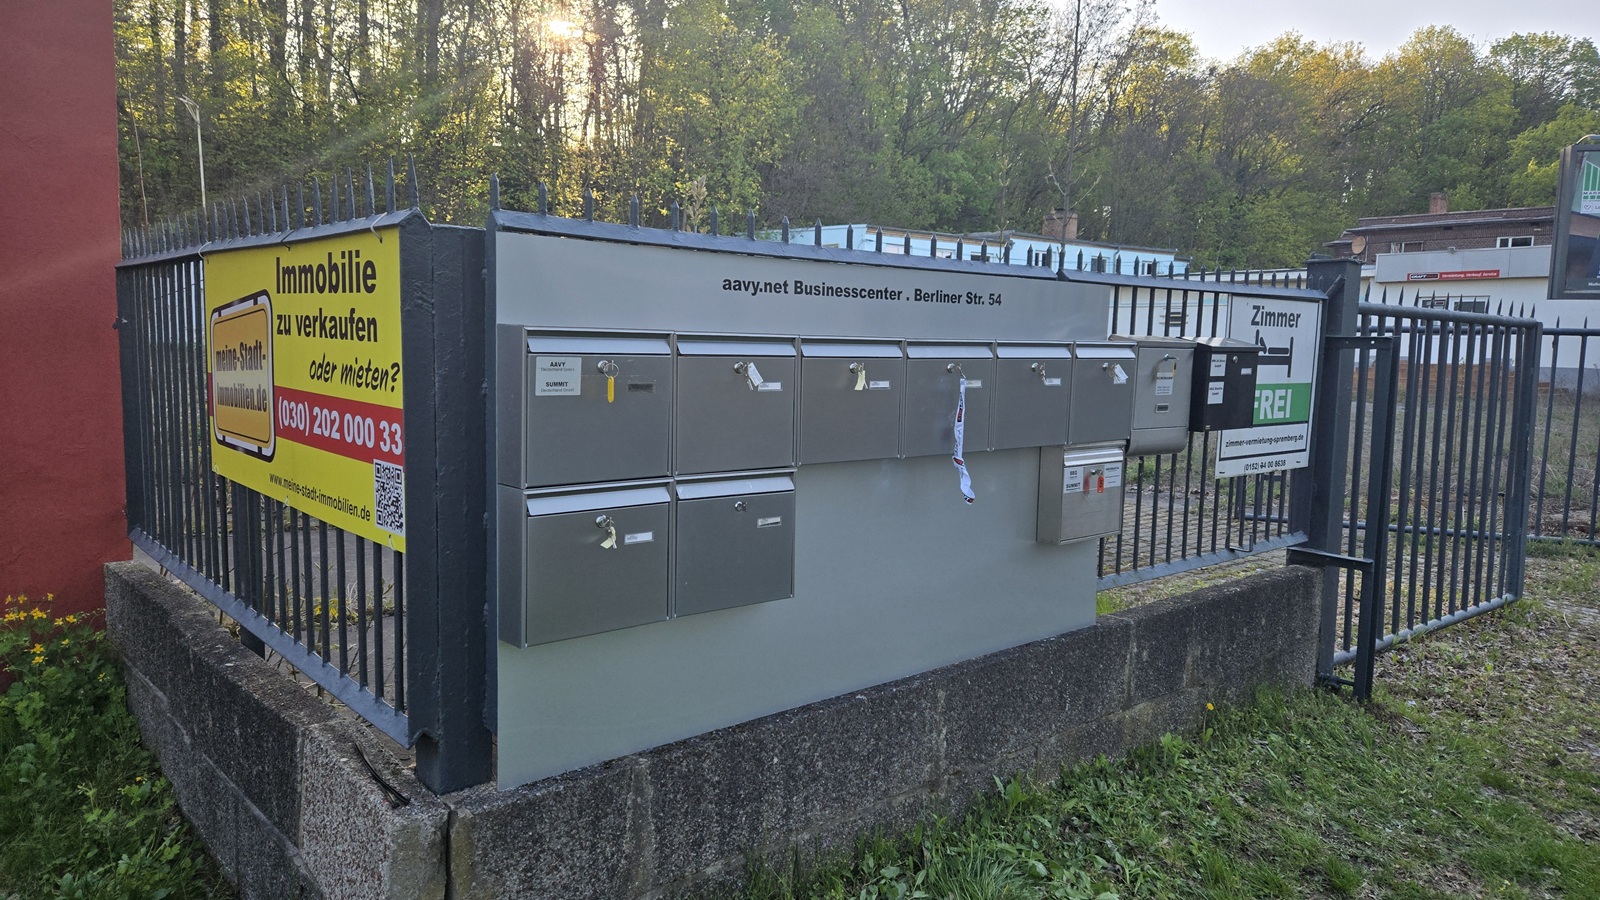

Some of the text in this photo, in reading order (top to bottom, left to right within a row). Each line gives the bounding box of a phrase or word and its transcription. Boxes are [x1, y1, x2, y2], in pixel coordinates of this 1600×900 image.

[276, 250, 377, 294] Immobilie
[722, 278, 789, 296] aavy.net
[794, 280, 903, 301] Businesscenter
[914, 288, 963, 305] Berliner
[966, 291, 985, 306] Str.
[988, 293, 1002, 306] 54
[276, 308, 378, 342] zu verkaufen
[1250, 305, 1301, 328] Zimmer
[216, 340, 266, 371] meine-Stadt-
[309, 352, 400, 393] oder mieten?
[217, 382, 267, 412] Immobilien.de
[279, 396, 403, 455] (030) 202 000 33
[1225, 434, 1304, 447] zimmer-vermietung-spremberg.de
[1244, 462, 1259, 473] (0152)
[269, 472, 371, 521] www.meine-stadt-immobilien.de
